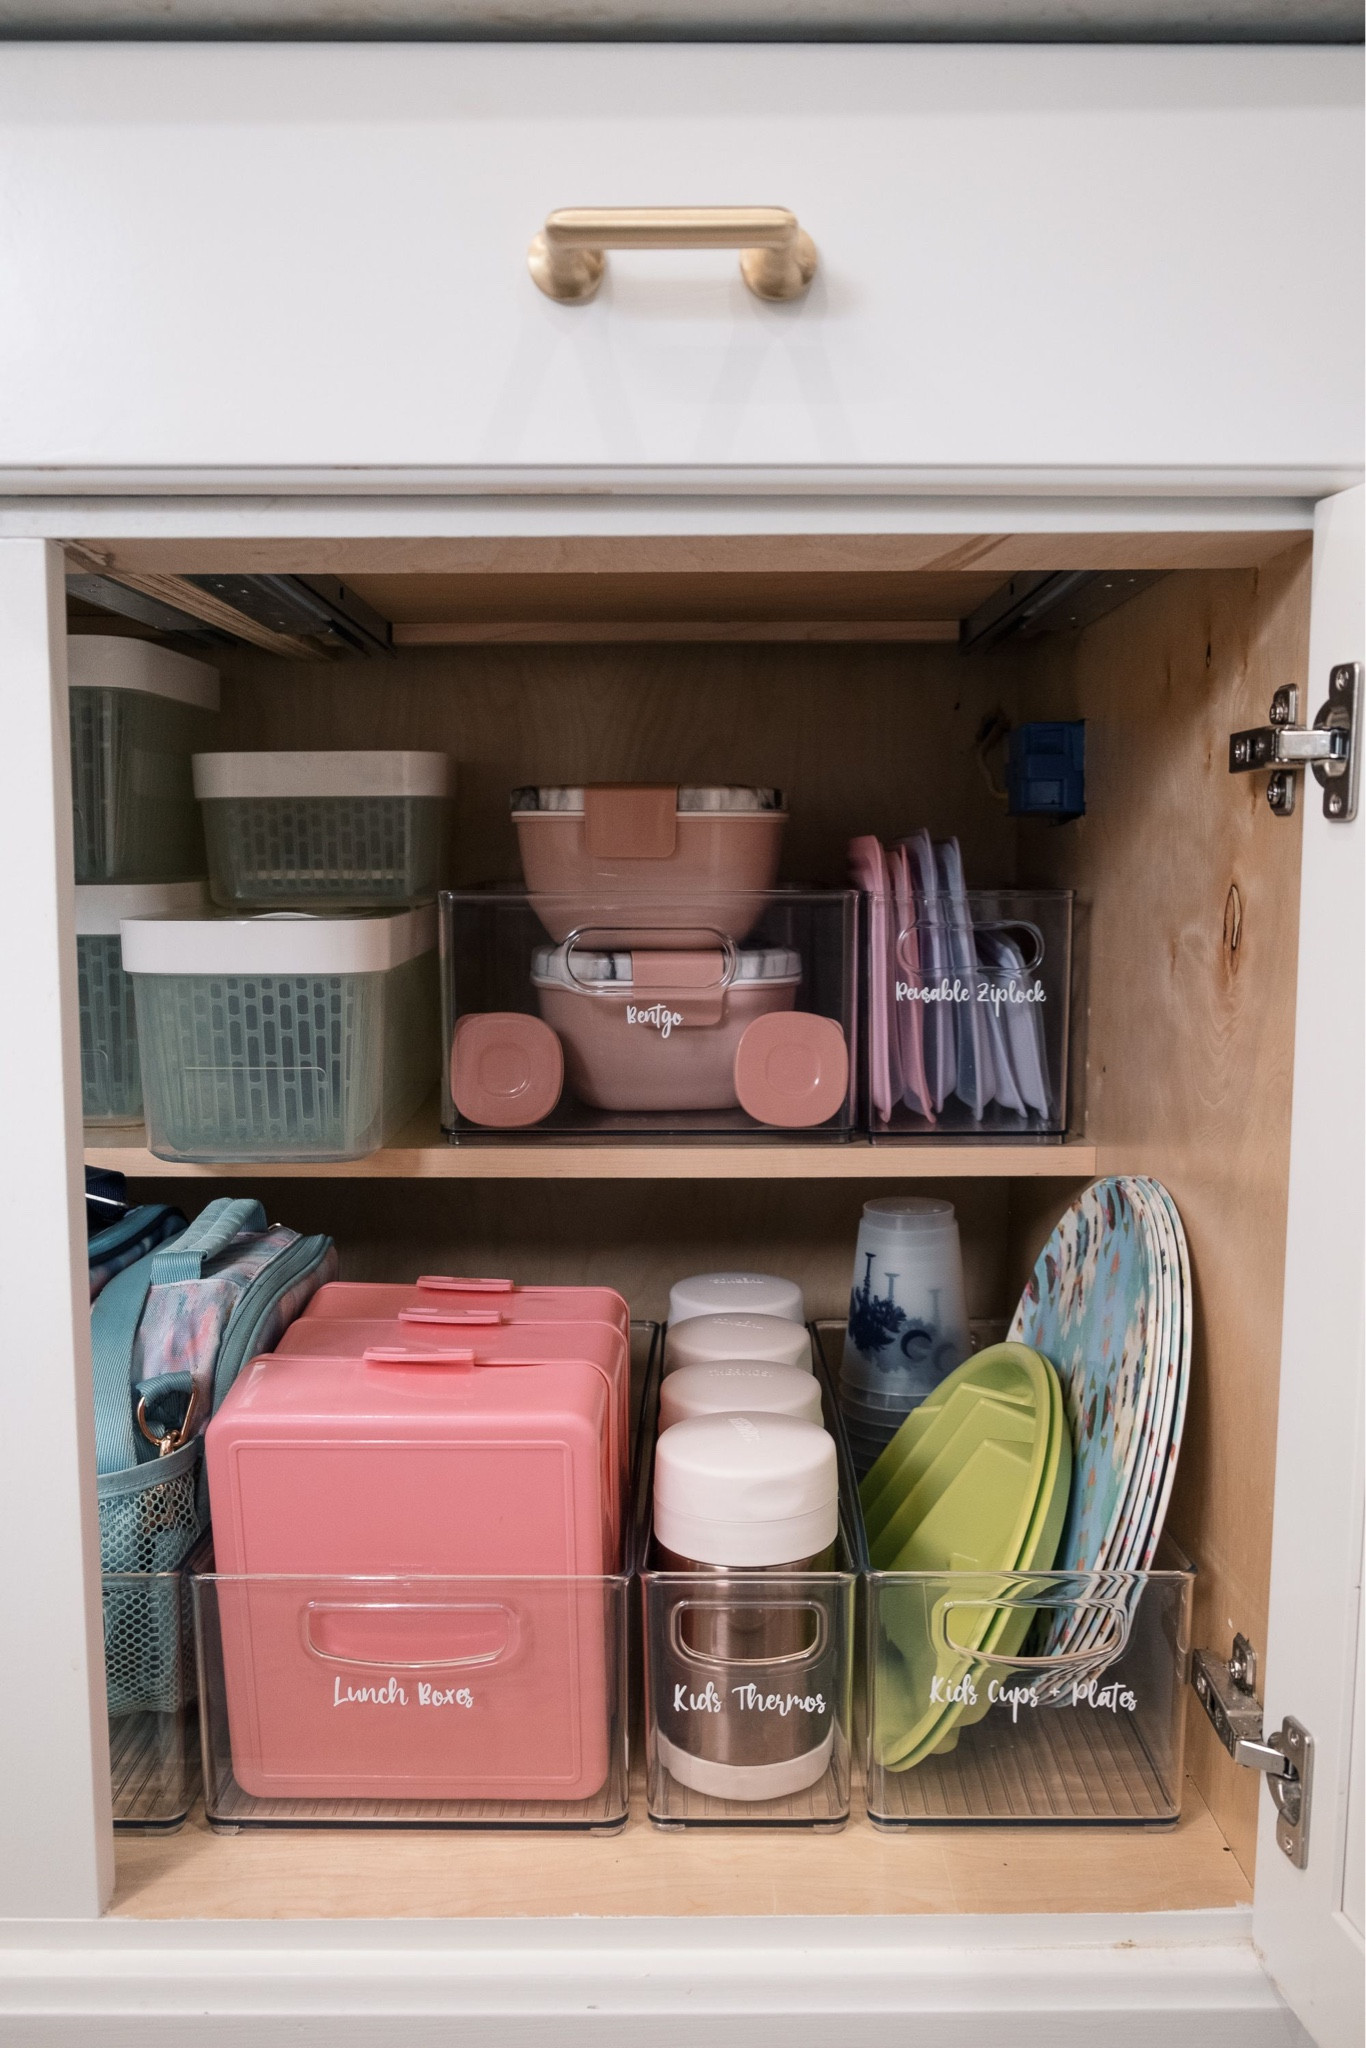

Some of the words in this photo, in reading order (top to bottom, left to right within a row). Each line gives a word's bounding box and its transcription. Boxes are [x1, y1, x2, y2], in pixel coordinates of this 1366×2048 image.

[895, 978, 970, 1003] Reusable
[976, 979, 1047, 1018] Ziplock
[626, 1003, 684, 1039] Bentgo
[333, 1676, 409, 1707] Lunch
[418, 1681, 474, 1709] Boxes
[673, 1681, 722, 1713] Kids
[731, 1682, 827, 1717] Thermos
[929, 1673, 978, 1705] Kids
[987, 1679, 1040, 1724] Cups
[1049, 1685, 1061, 1697] +
[1071, 1679, 1138, 1713] Plates
